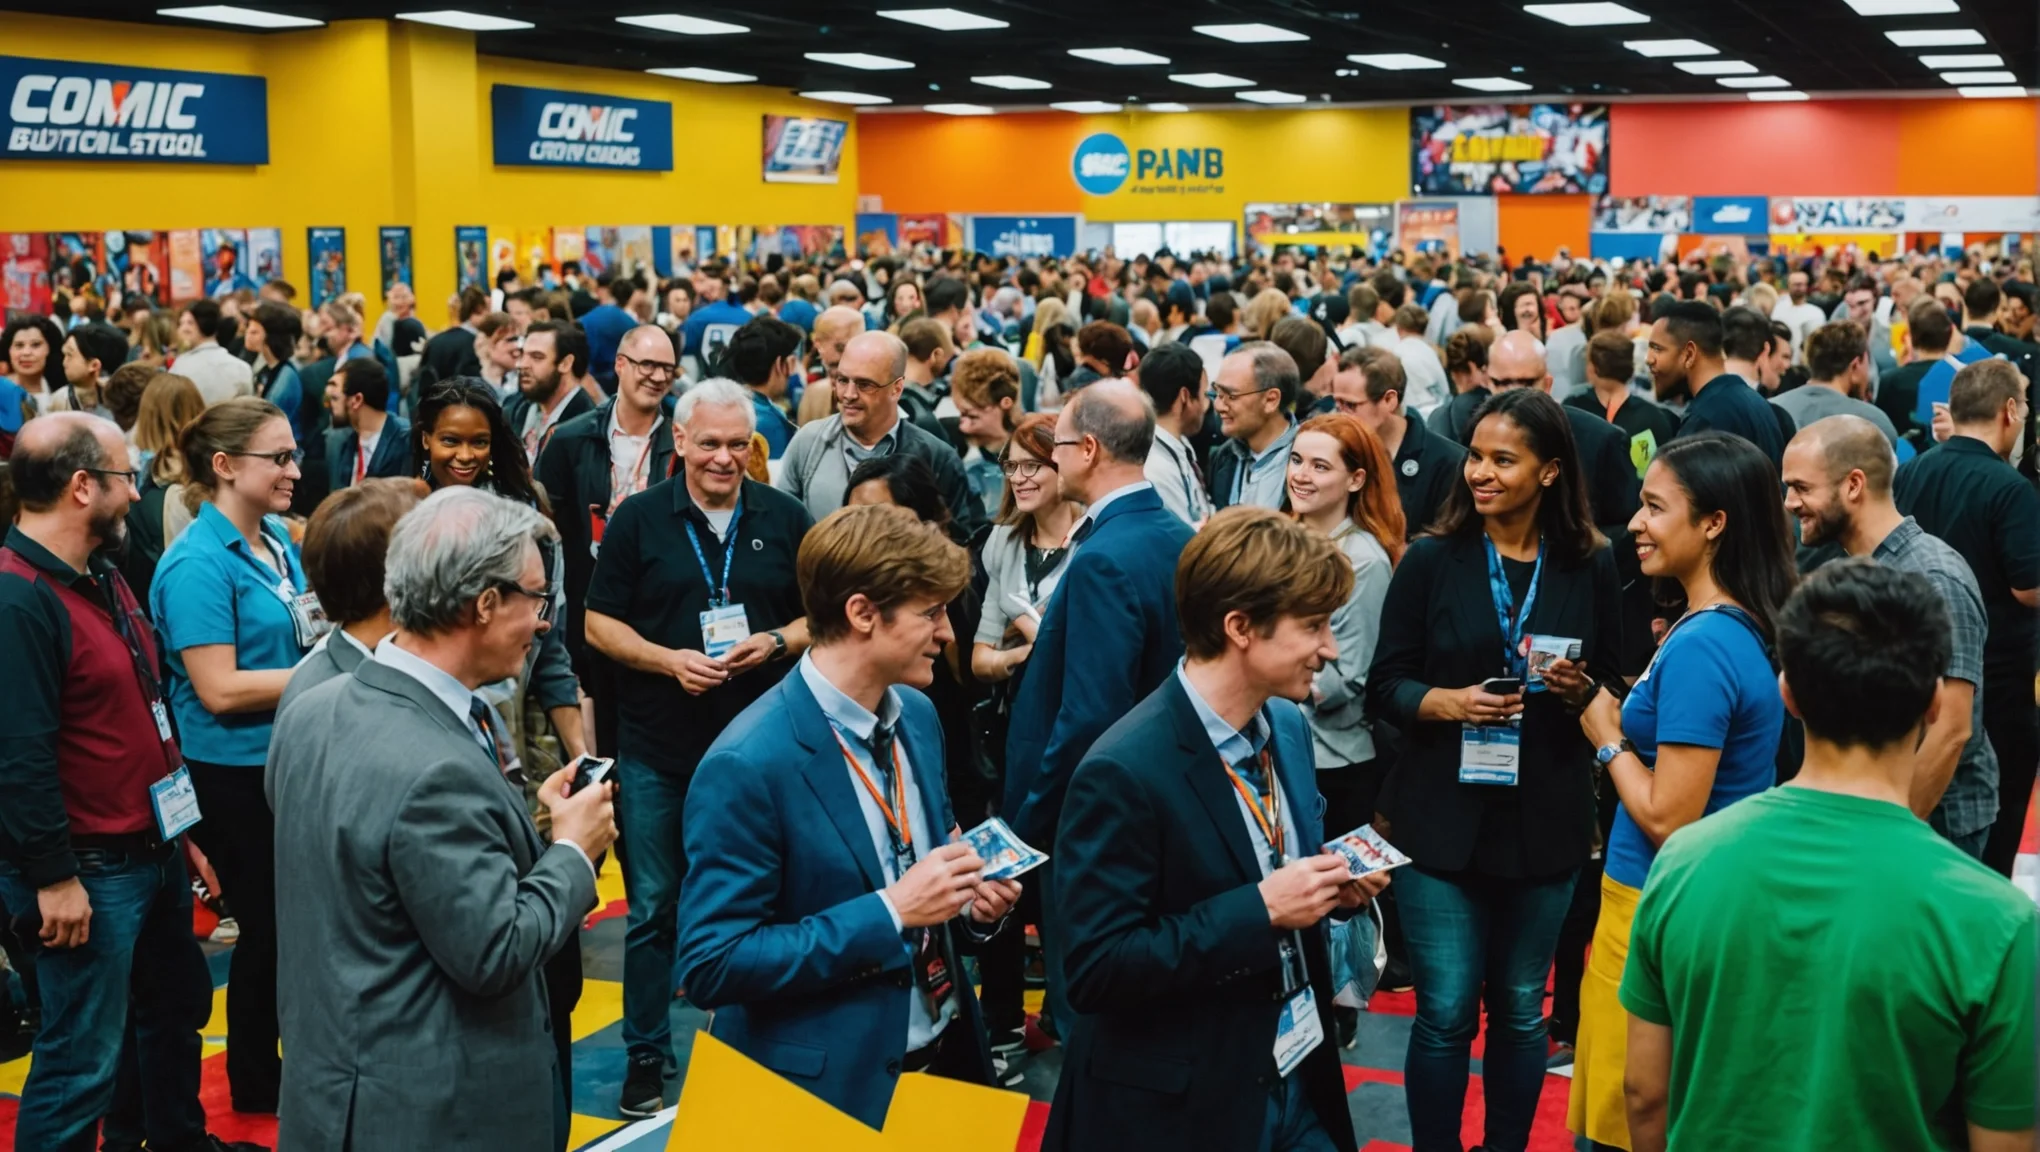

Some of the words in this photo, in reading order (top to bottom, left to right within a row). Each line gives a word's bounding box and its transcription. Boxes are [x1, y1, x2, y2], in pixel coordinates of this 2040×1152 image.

[9, 74, 205, 130] COMIC
[537, 102, 638, 143] COMIC
[1137, 148, 1224, 180] PANB
